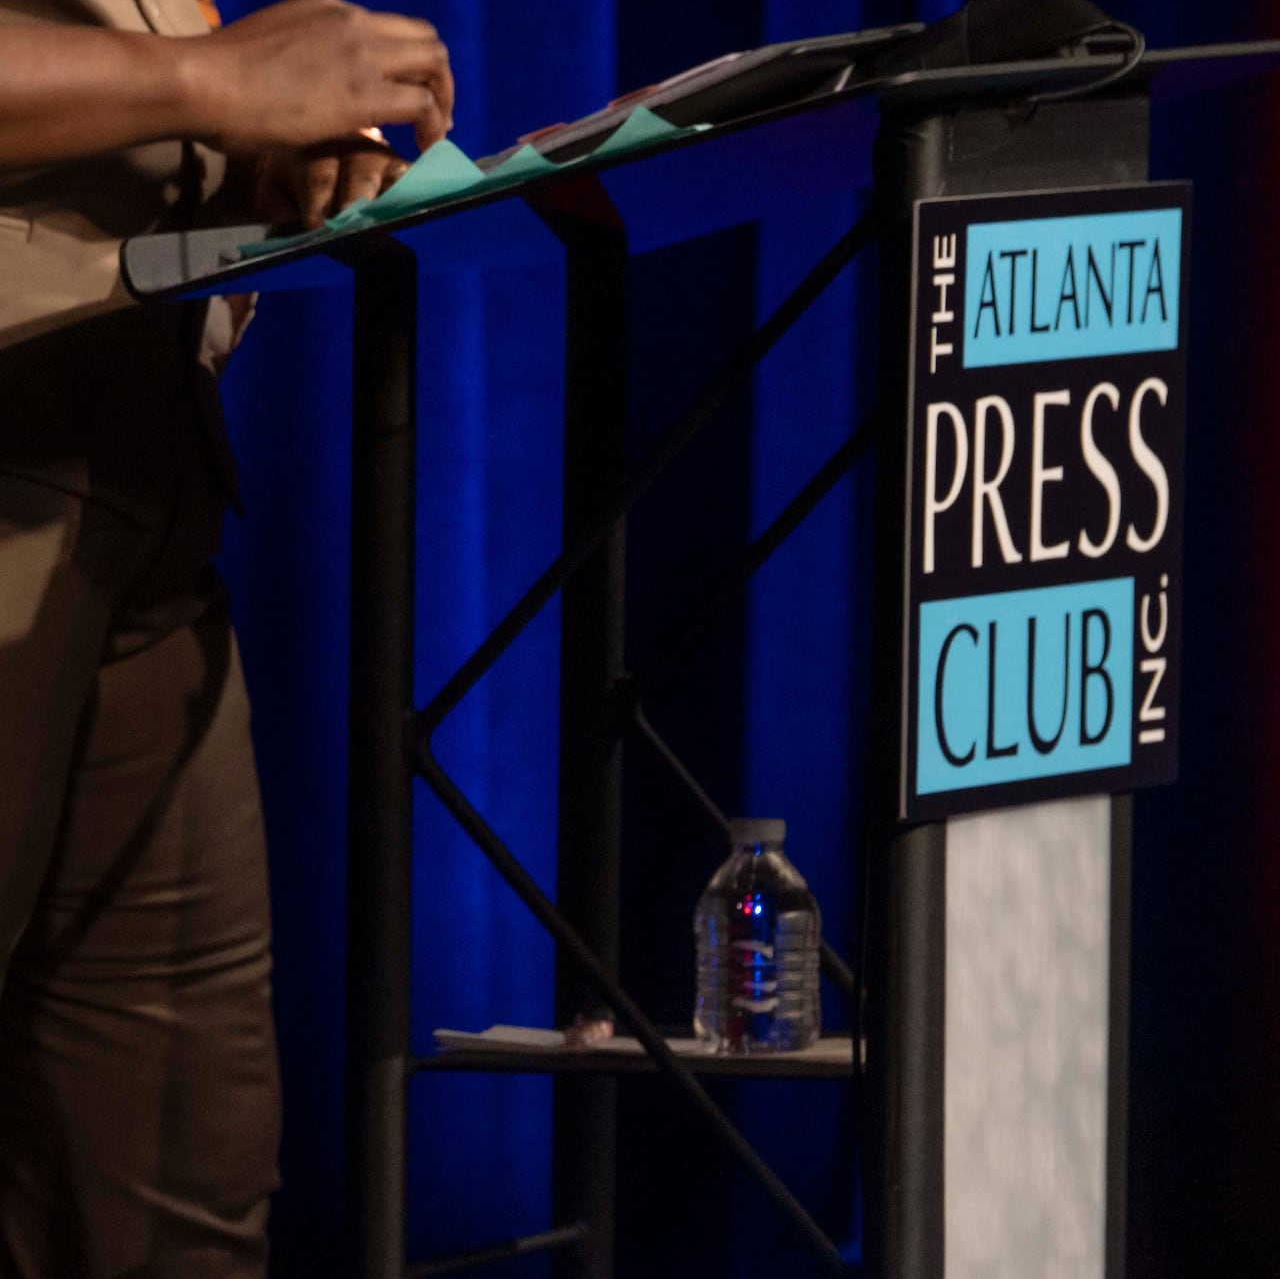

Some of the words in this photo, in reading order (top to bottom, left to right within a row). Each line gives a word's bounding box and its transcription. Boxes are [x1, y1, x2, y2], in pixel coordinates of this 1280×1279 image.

[930, 233, 956, 373] THE
[973, 237, 1168, 338] ATLANTA
[923, 377, 1169, 574] PRESS
[933, 607, 1114, 767] CLUB
[1138, 573, 1168, 744] INC.
